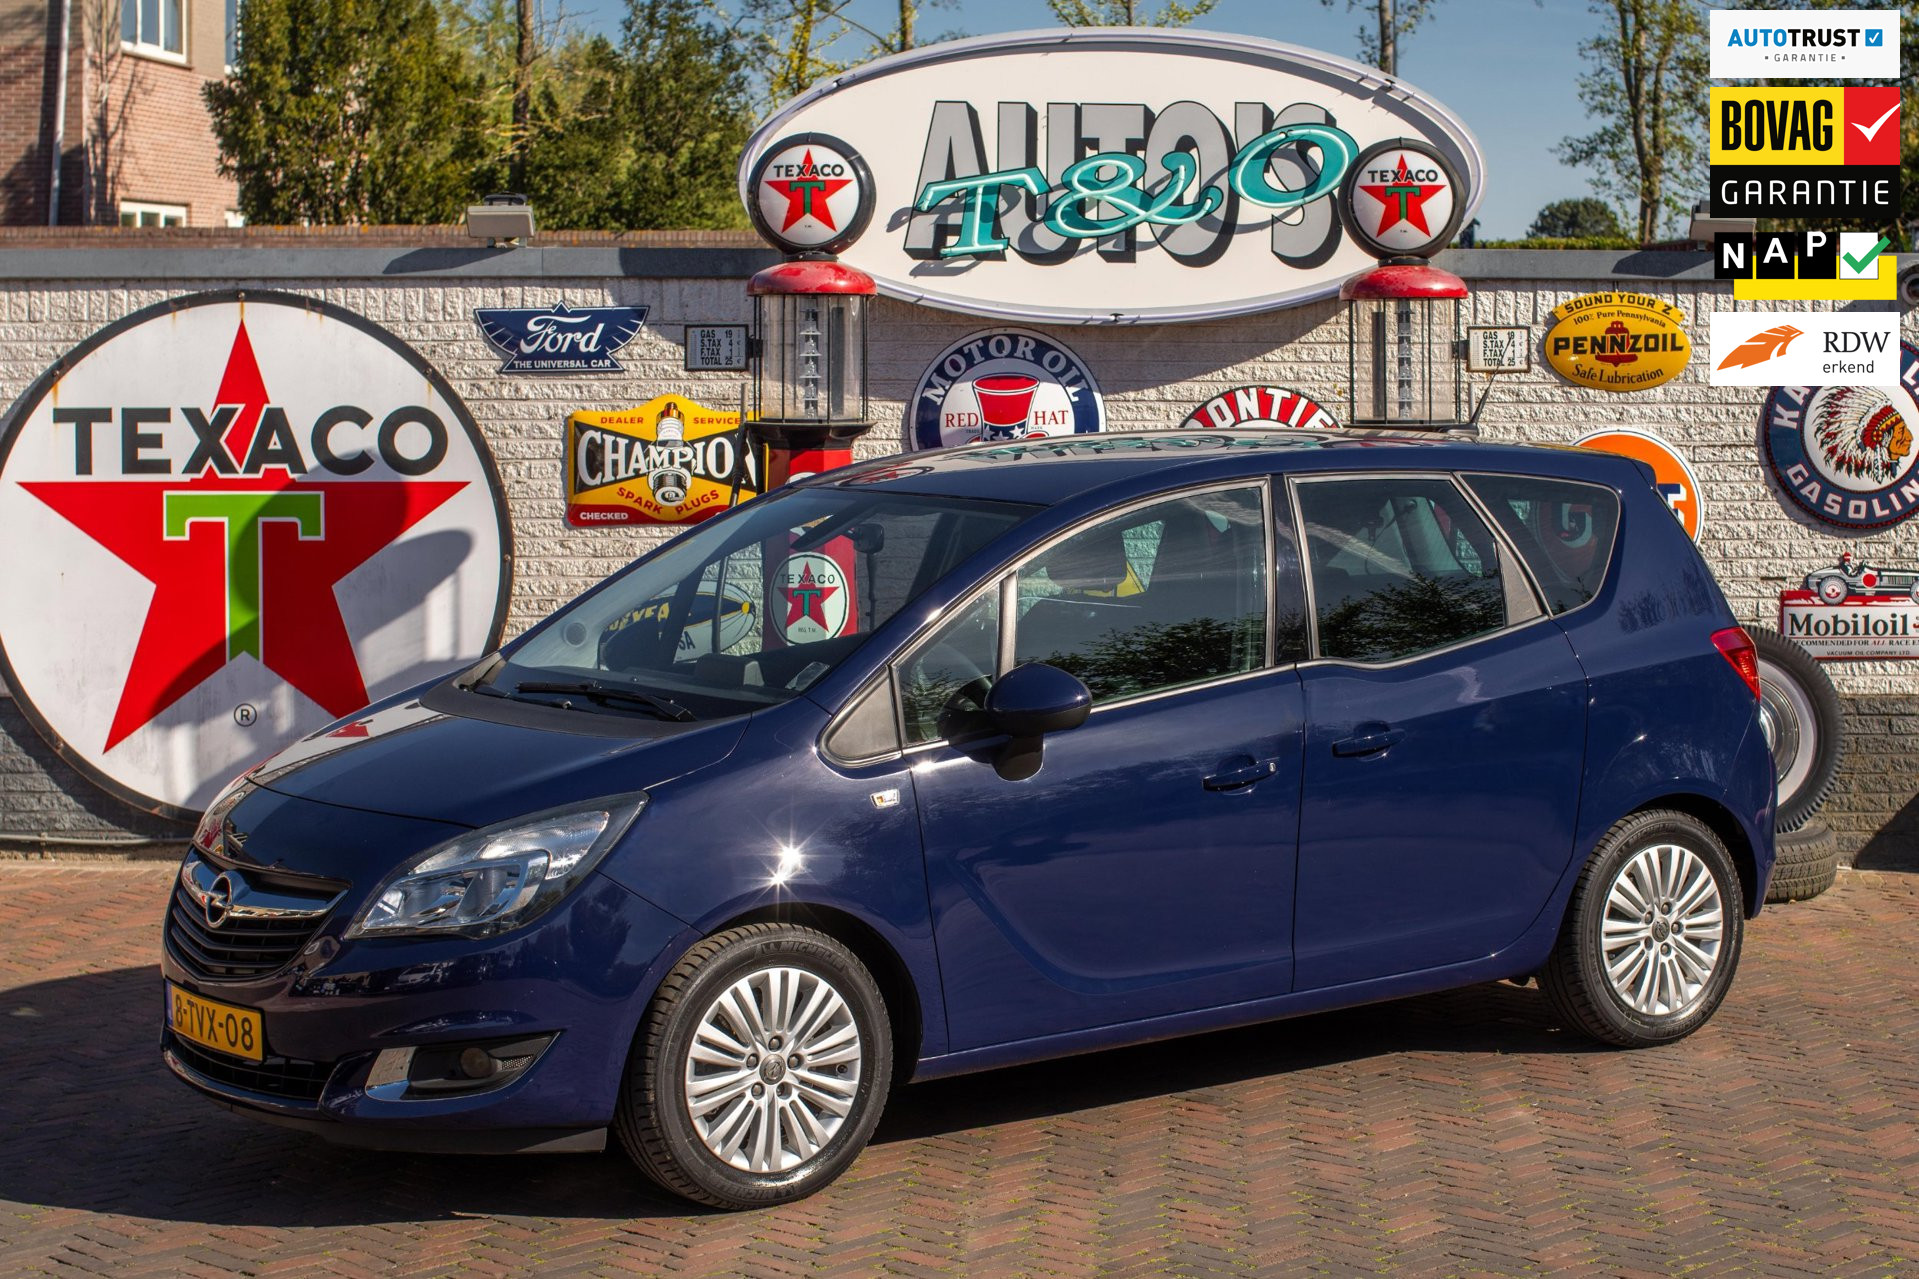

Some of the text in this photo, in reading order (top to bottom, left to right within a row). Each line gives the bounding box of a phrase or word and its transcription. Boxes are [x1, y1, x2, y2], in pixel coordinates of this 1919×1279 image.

[773, 164, 844, 178] TEXACO
[1368, 169, 1438, 182] TEXACO
[1564, 294, 1674, 315] SOUND YOUR Z
[1597, 311, 1616, 319] Pure
[1617, 310, 1667, 328] Pennsylvania
[520, 315, 605, 354] Ford
[700, 329, 716, 339] GAS
[1482, 331, 1498, 340] GAS
[700, 339, 722, 348] S.TAX
[1482, 340, 1505, 349] S.TAX
[1553, 333, 1685, 356] PENNZOIL
[700, 348, 721, 357] F.TAX
[1482, 349, 1504, 358] F.TAX
[514, 359, 611, 369] THE UNIVERSAL CAR
[700, 357, 733, 366] TOTAL 25
[1482, 358, 1516, 367] TOTAL 25
[922, 335, 1091, 406] MOTOR OIL
[1572, 363, 1664, 385] Safe Lubrication
[693, 416, 740, 425] SERVICE
[945, 410, 1069, 428] RED HAT
[53, 405, 449, 476] TEXACO
[616, 486, 720, 515] SPARK PLUGS
[579, 512, 629, 520] CHECKED
[780, 574, 835, 584] TEXACO
[1789, 613, 1909, 636] Mobiloil
[175, 994, 254, 1051] 8-TVX-08
